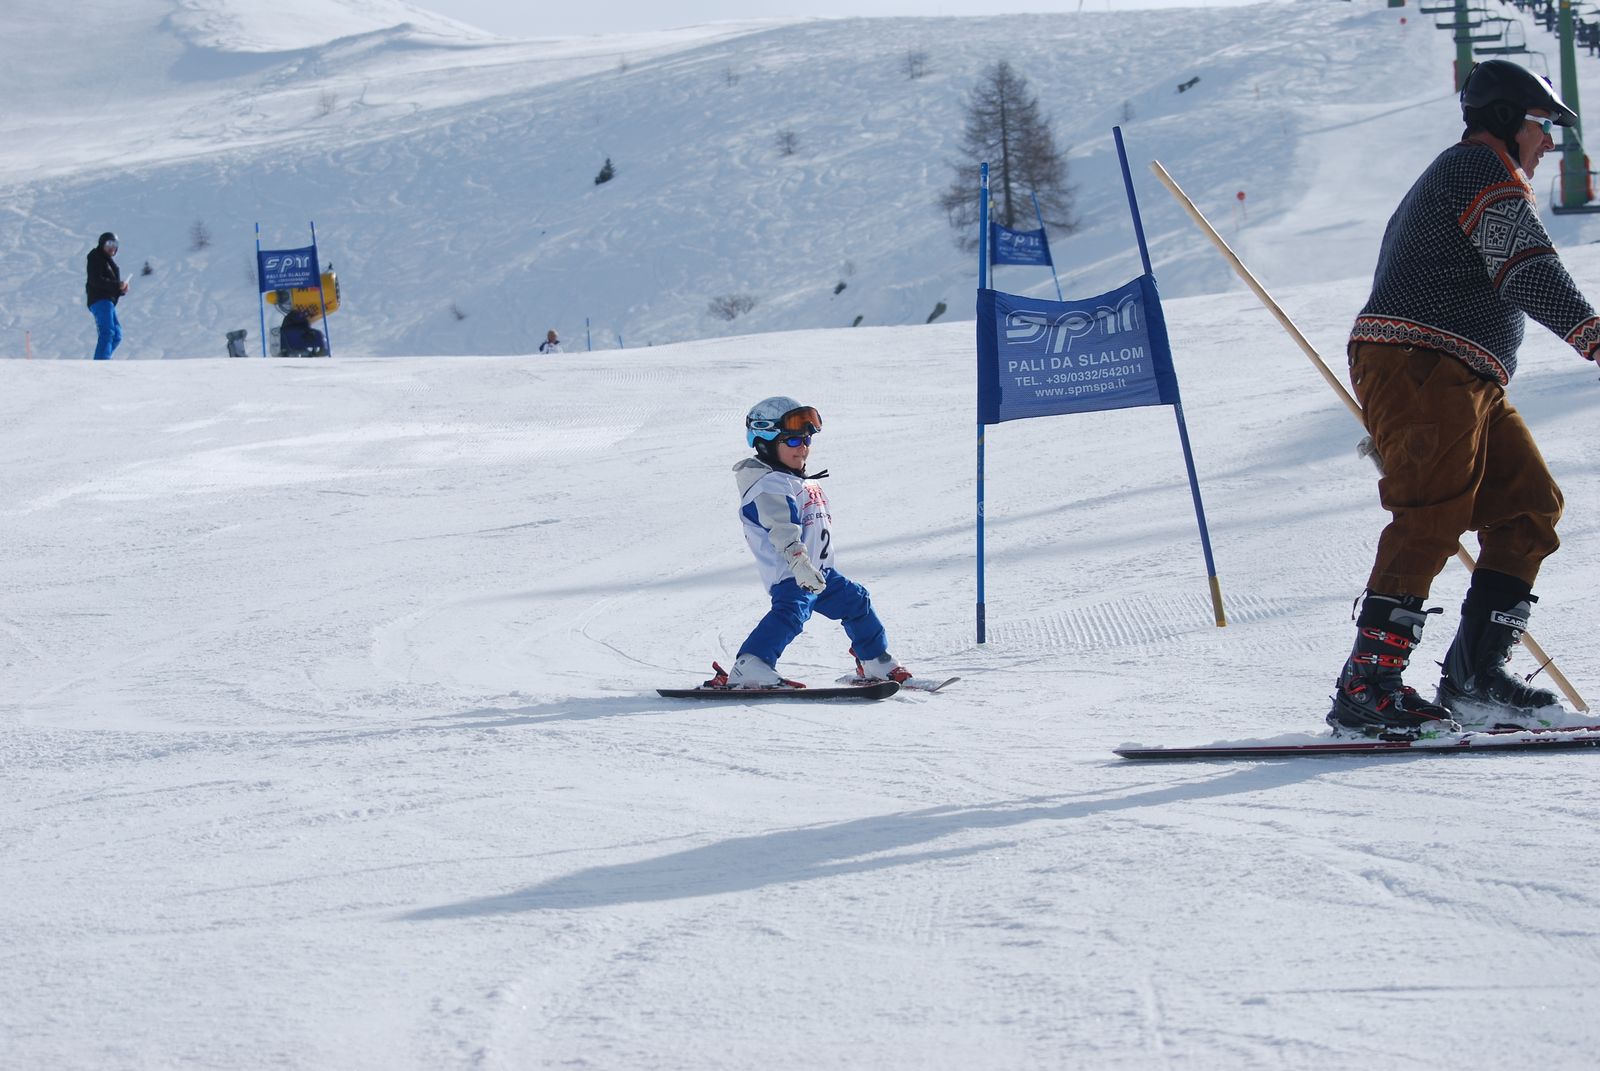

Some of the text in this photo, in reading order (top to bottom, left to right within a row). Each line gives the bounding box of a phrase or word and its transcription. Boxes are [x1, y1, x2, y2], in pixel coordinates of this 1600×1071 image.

[1008, 346, 1145, 374] PALI DA SLALOM
[1014, 363, 1143, 387] TEL. +39/0332/542011
[1035, 379, 1127, 398] www.spmspa.it
[819, 528, 831, 560] 2
